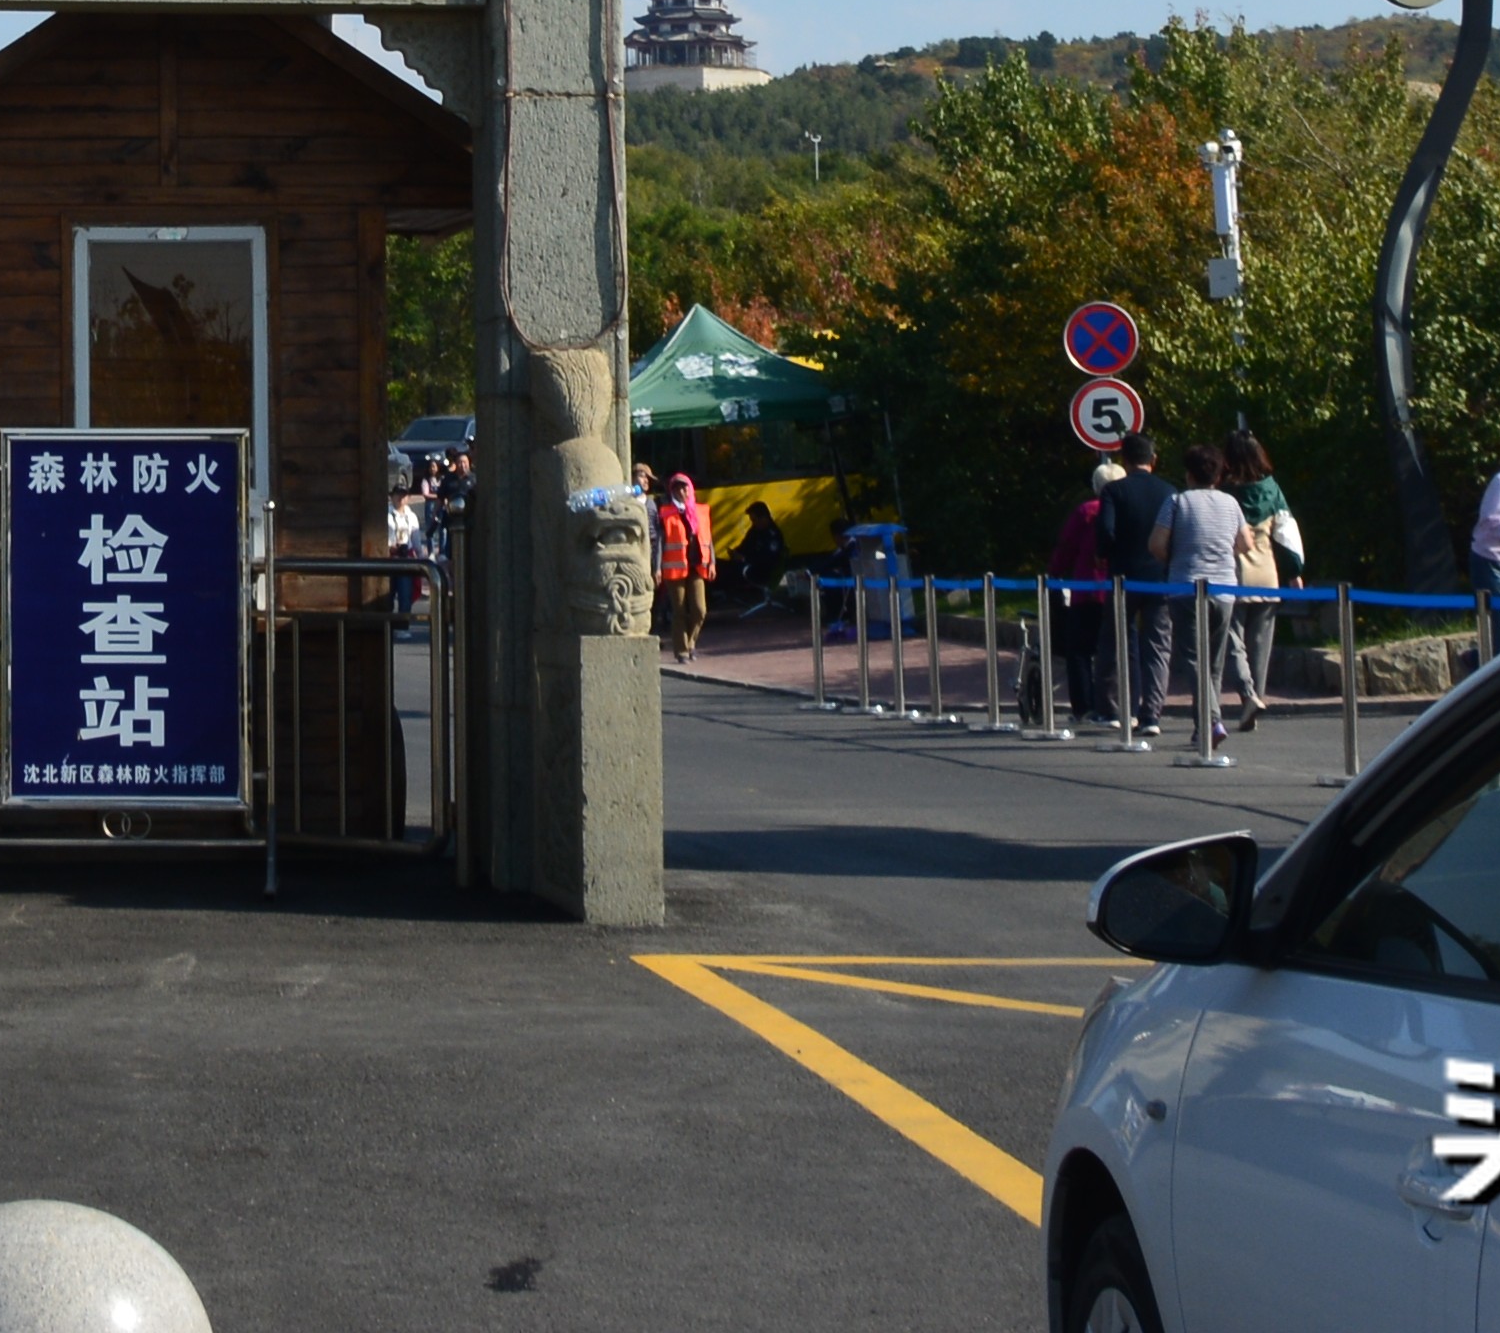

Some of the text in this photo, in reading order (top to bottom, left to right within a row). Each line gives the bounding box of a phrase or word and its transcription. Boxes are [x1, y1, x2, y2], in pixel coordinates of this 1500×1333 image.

[1091, 397, 1127, 434] 5
[27, 451, 222, 495] 森林防火
[77, 514, 170, 747] 检查站
[23, 764, 226, 785] 沈北新区森林防火指挥部
